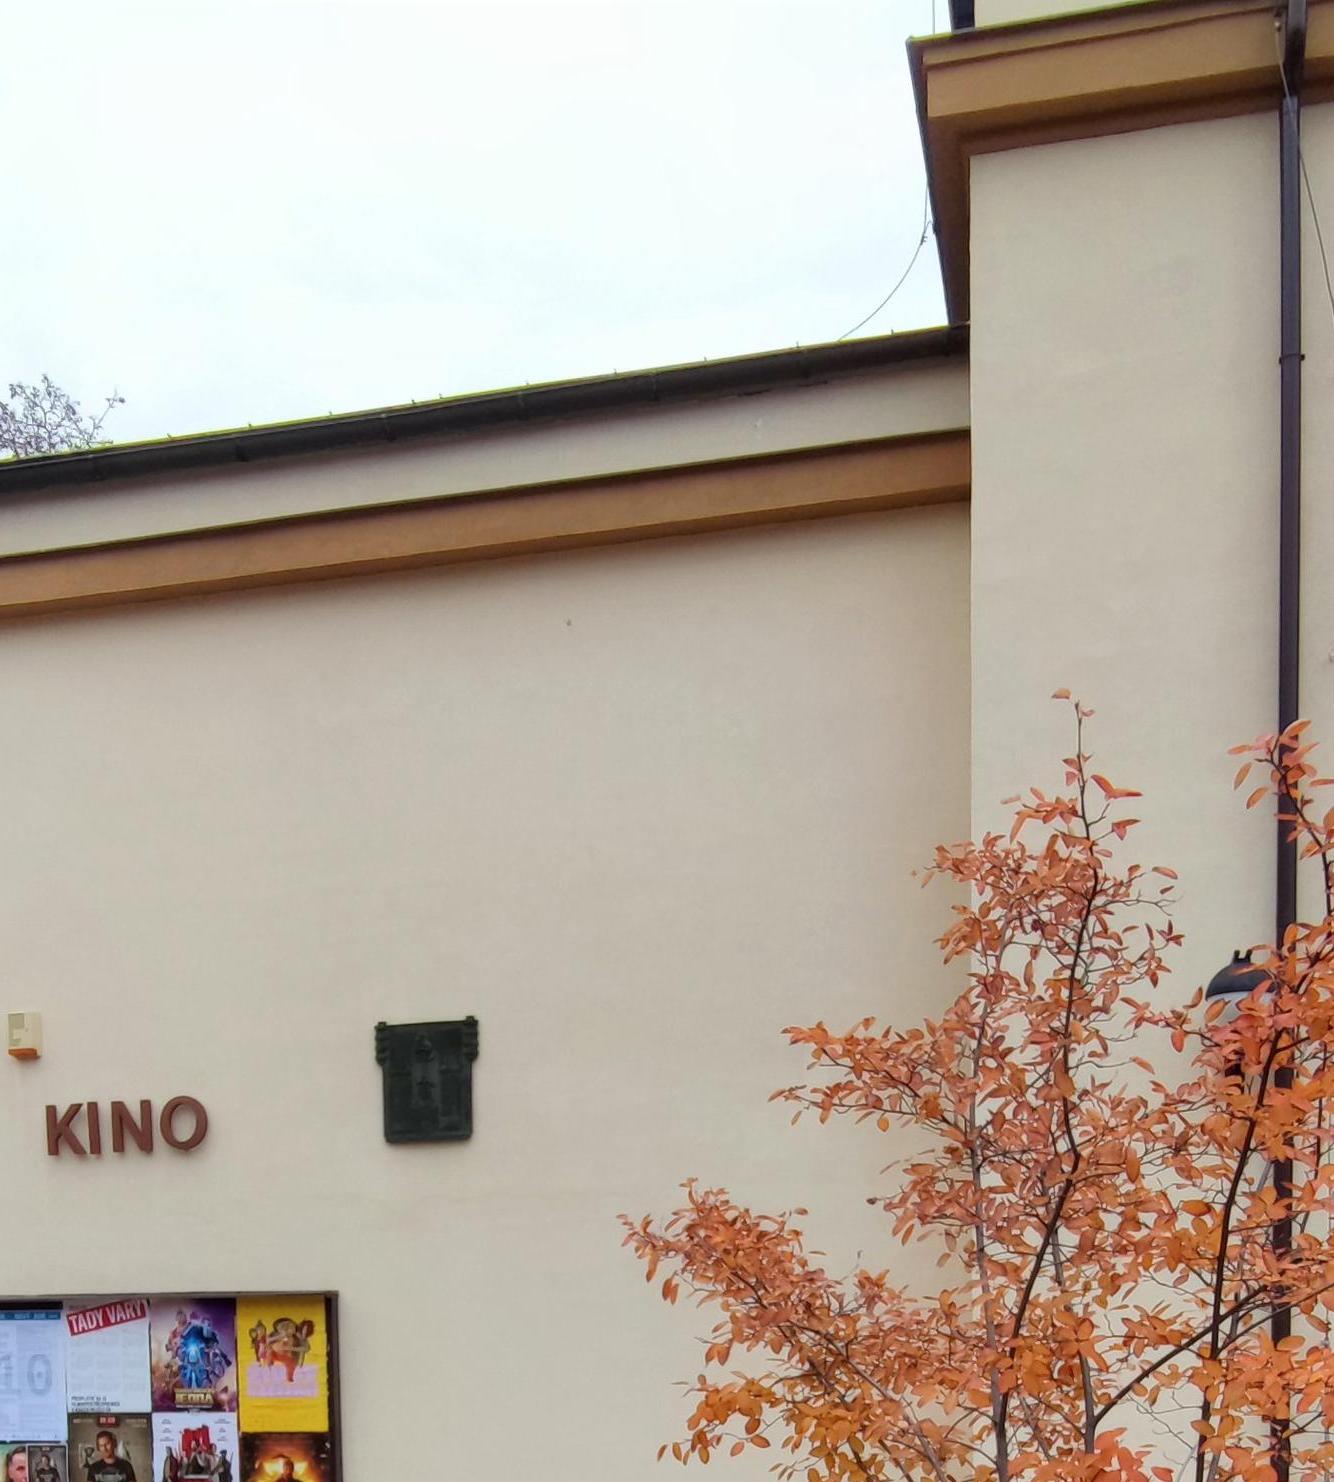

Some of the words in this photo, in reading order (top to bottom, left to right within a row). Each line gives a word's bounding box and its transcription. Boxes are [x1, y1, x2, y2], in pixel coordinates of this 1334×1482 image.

[45, 1095, 208, 1156] KINO
[69, 1308, 104, 1333] TADY
[105, 1300, 142, 1324] VARY
